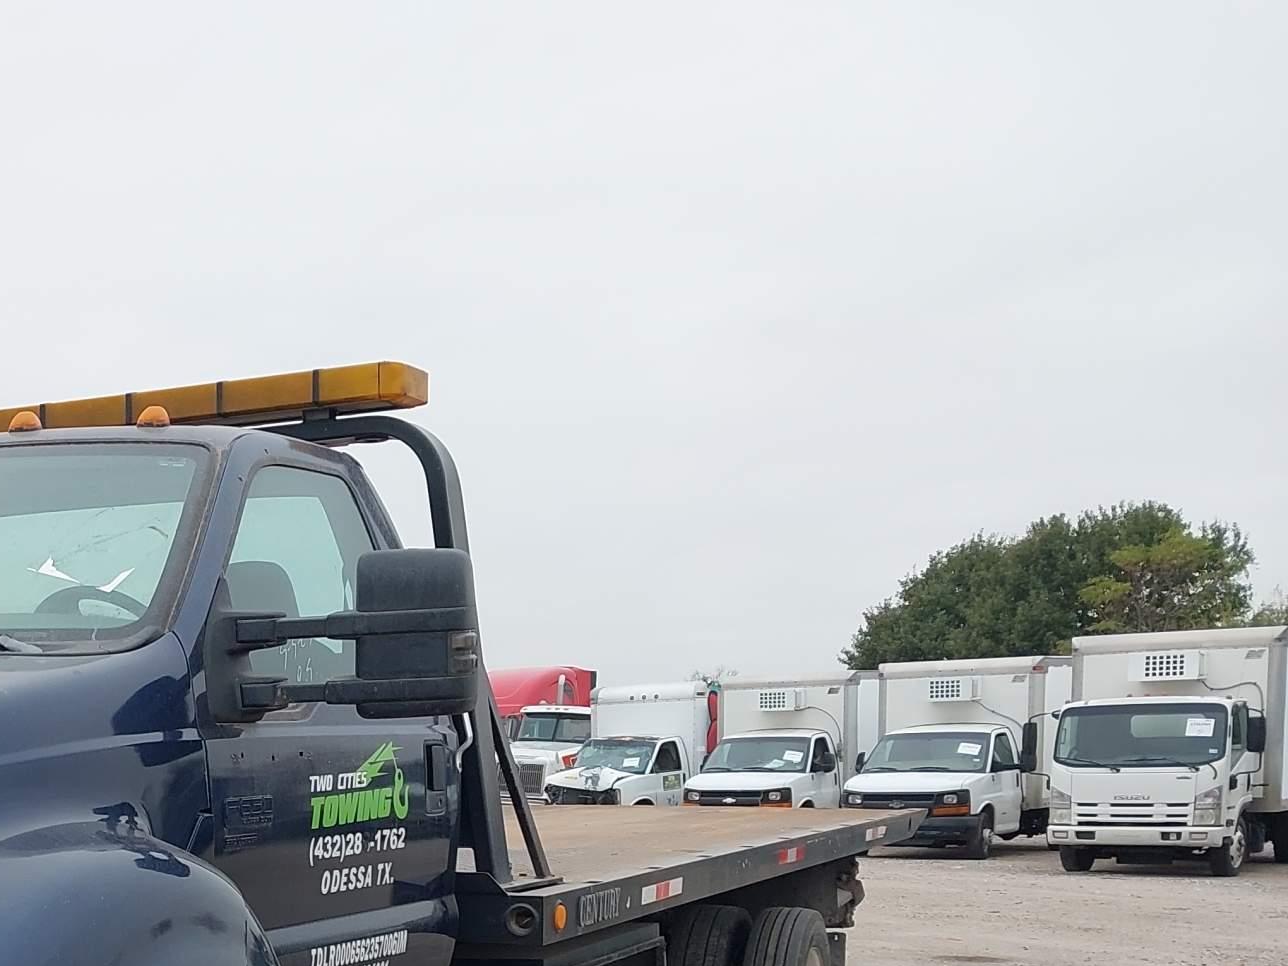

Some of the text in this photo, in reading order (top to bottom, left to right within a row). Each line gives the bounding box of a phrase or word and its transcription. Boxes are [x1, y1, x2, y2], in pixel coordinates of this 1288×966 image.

[309, 771, 368, 792] TWO CITIES
[311, 787, 392, 830] TOWING
[321, 862, 395, 895] ODESSA TX.
[578, 887, 621, 928] CENTURY
